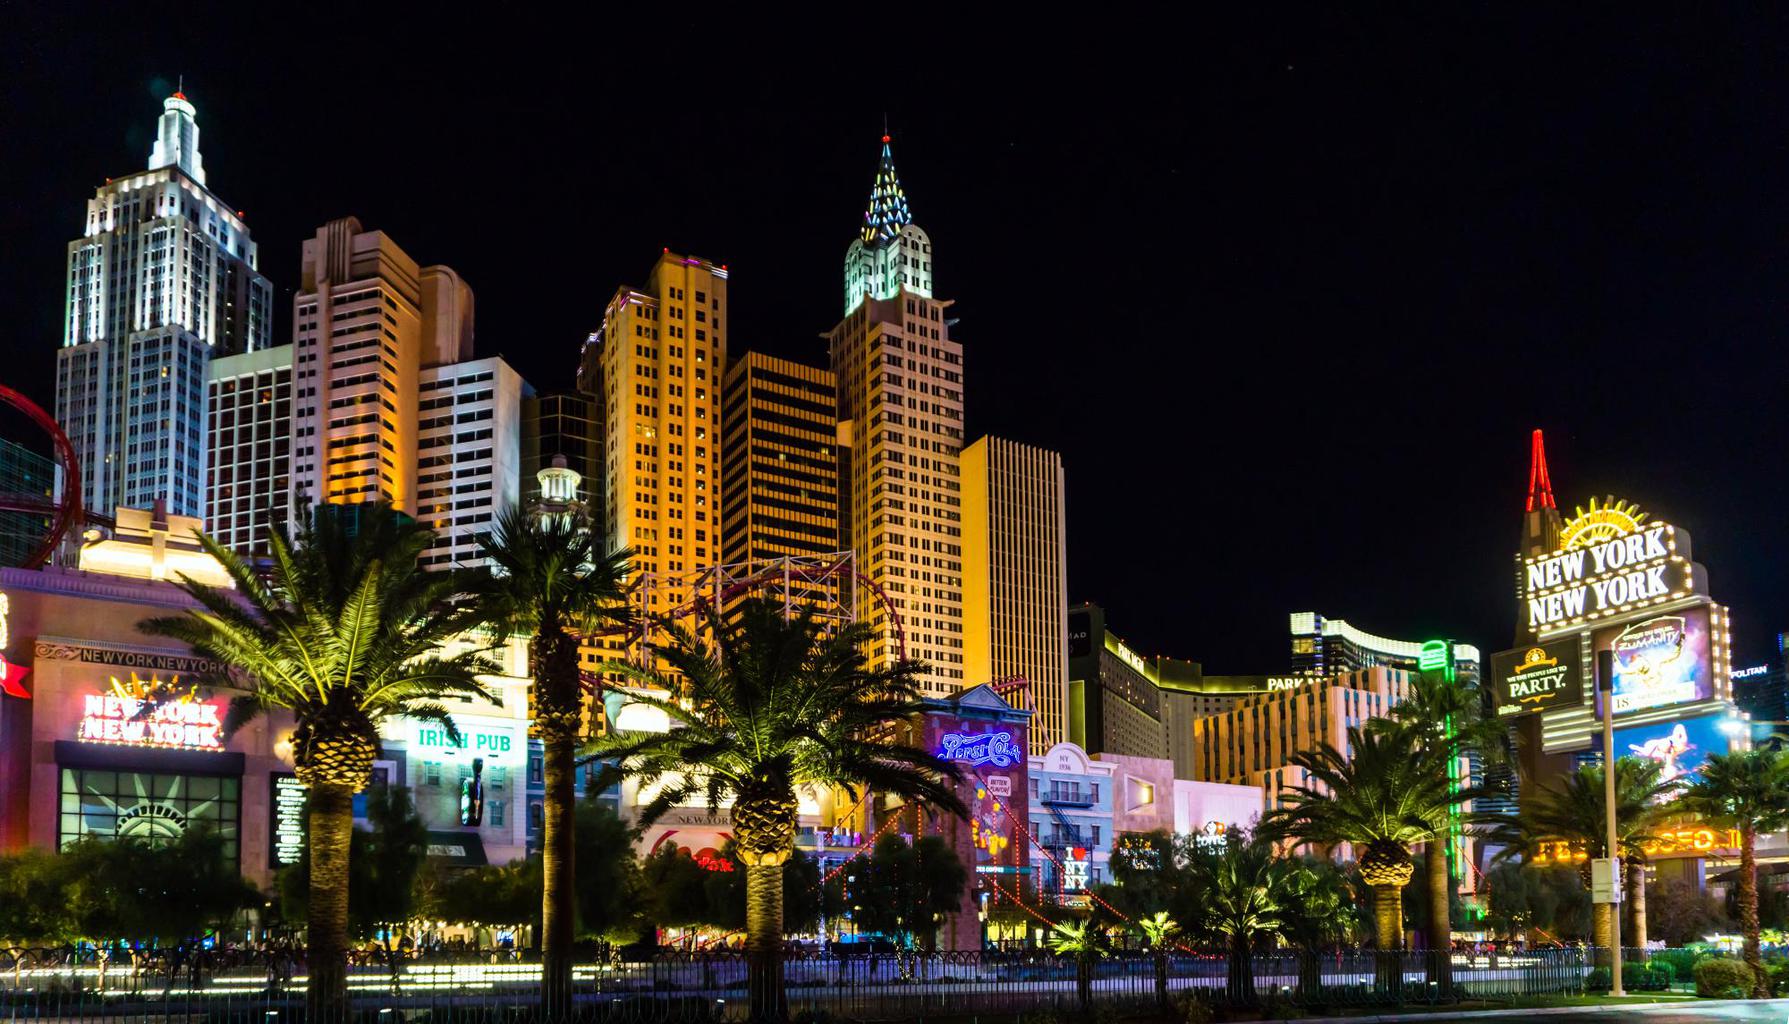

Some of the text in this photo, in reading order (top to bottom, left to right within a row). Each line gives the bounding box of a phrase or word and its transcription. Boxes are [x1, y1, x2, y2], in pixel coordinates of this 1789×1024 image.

[1526, 526, 1668, 592] NEW YORK
[1528, 564, 1669, 627] NEW YORK
[82, 650, 226, 674] NEW YORK NEW YORK
[1267, 678, 1304, 691] PARK
[1509, 673, 1566, 698] PARTY.
[84, 717, 219, 748] NEW YORK
[476, 734, 511, 752] PUB
[679, 816, 702, 825] NEW
[1065, 847, 1073, 860] I
[1064, 861, 1088, 875] NY
[1064, 875, 1088, 889] NY
